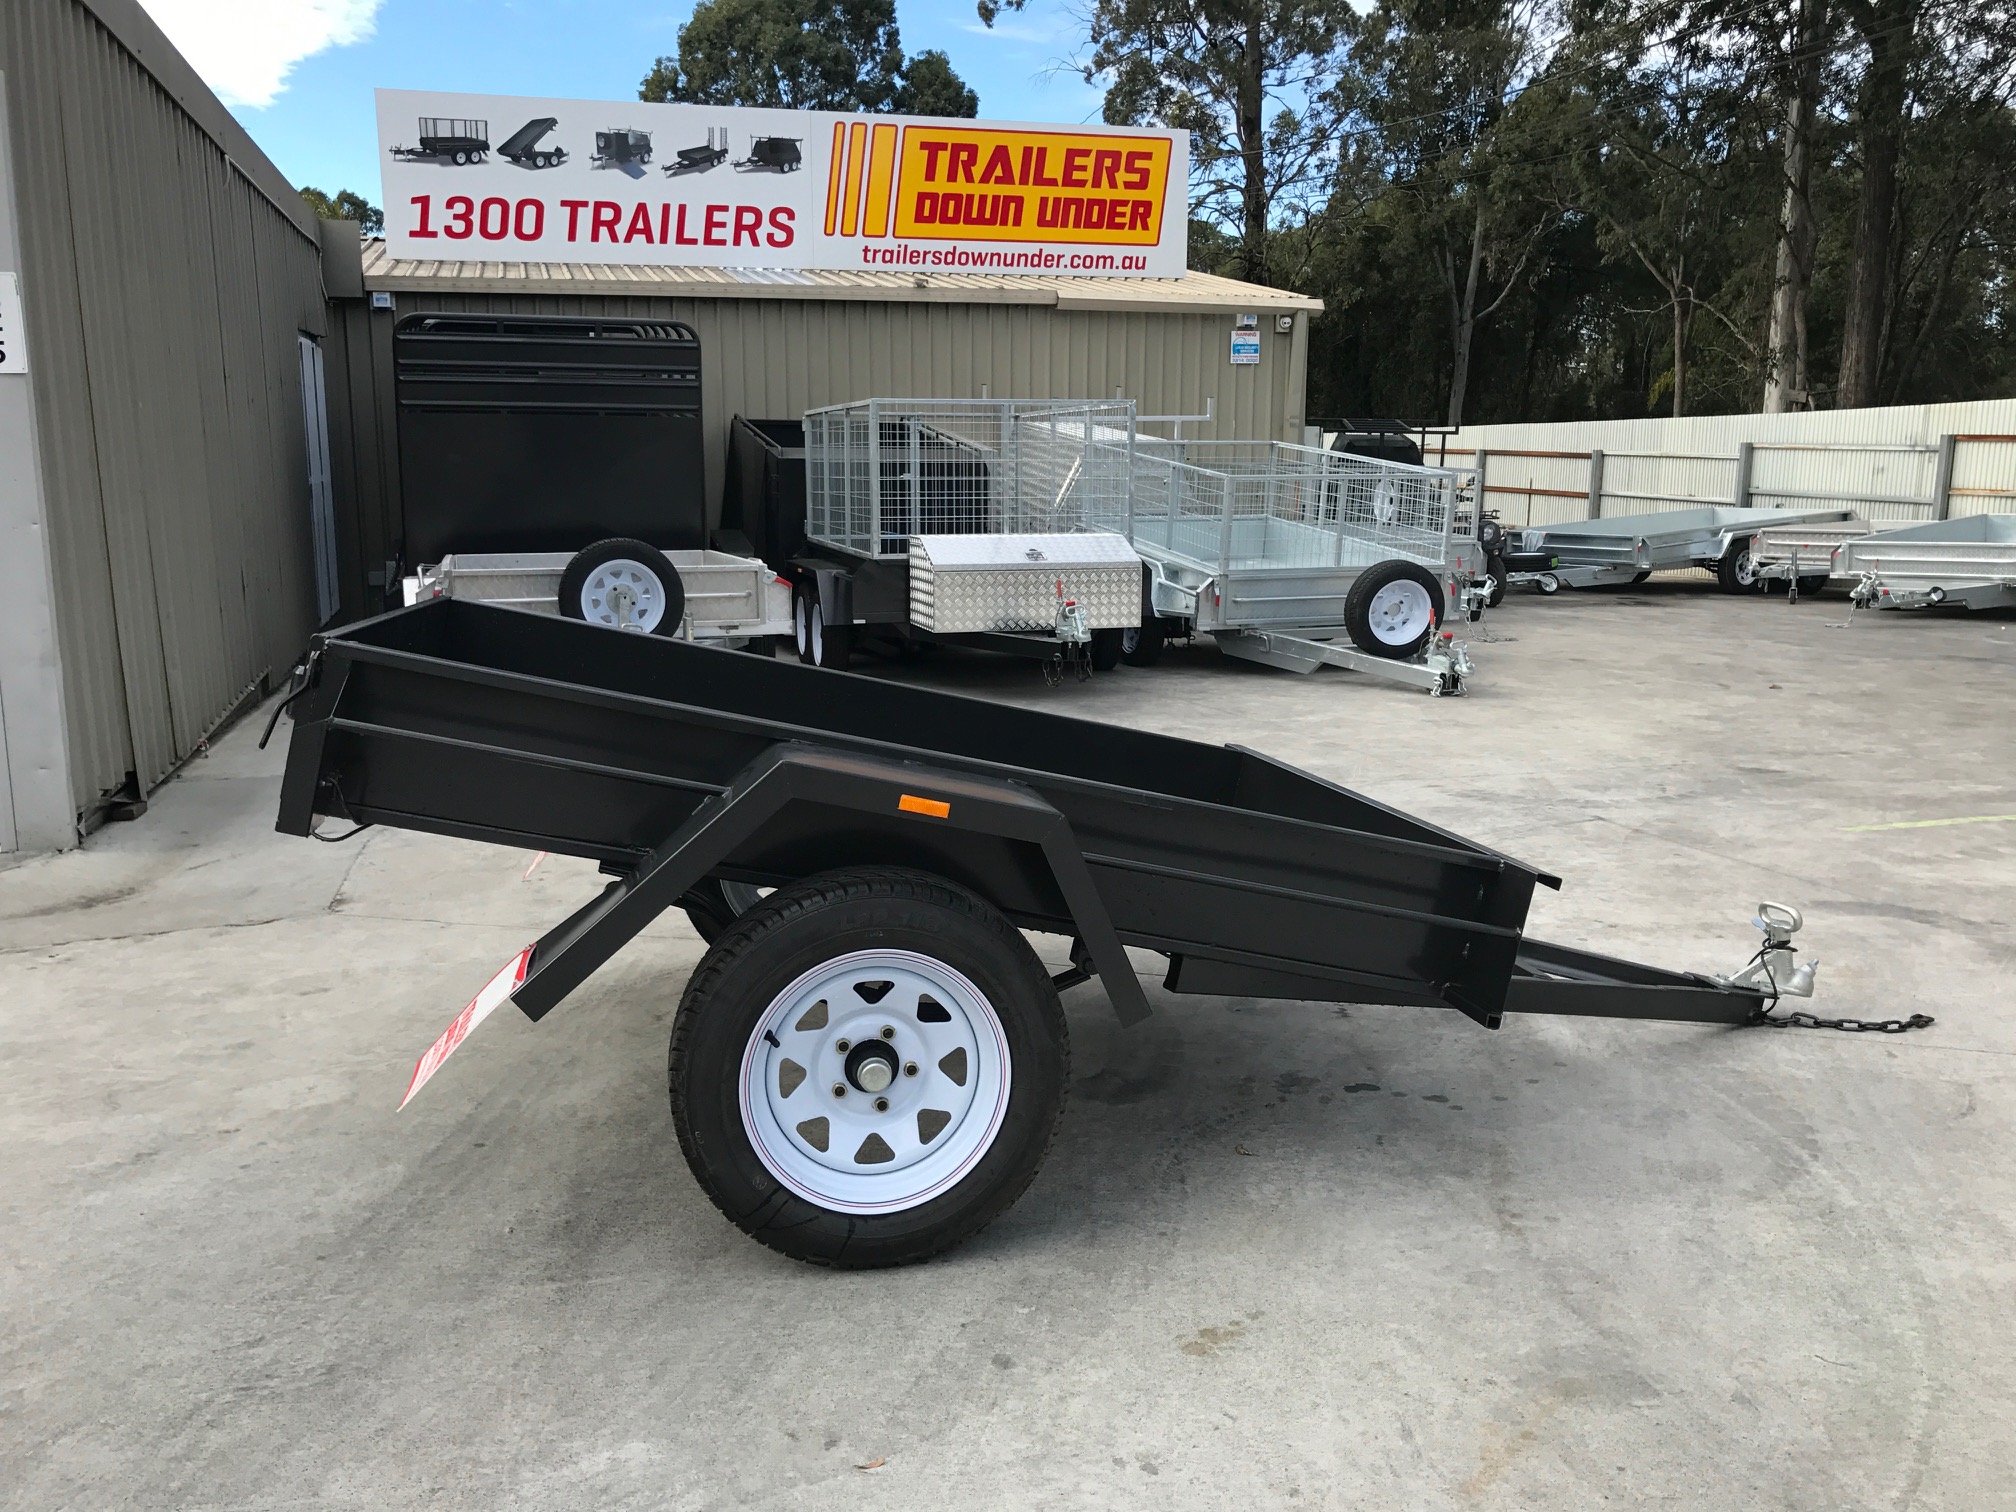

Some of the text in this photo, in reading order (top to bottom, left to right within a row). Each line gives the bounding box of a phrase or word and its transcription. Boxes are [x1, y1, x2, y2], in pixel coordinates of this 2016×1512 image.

[919, 140, 1154, 191] TRAILERS
[408, 194, 796, 249] 1300 TRAILERS
[913, 191, 1153, 232] DOWN UNDER
[862, 243, 1147, 271] trailersdownunder.com.au
